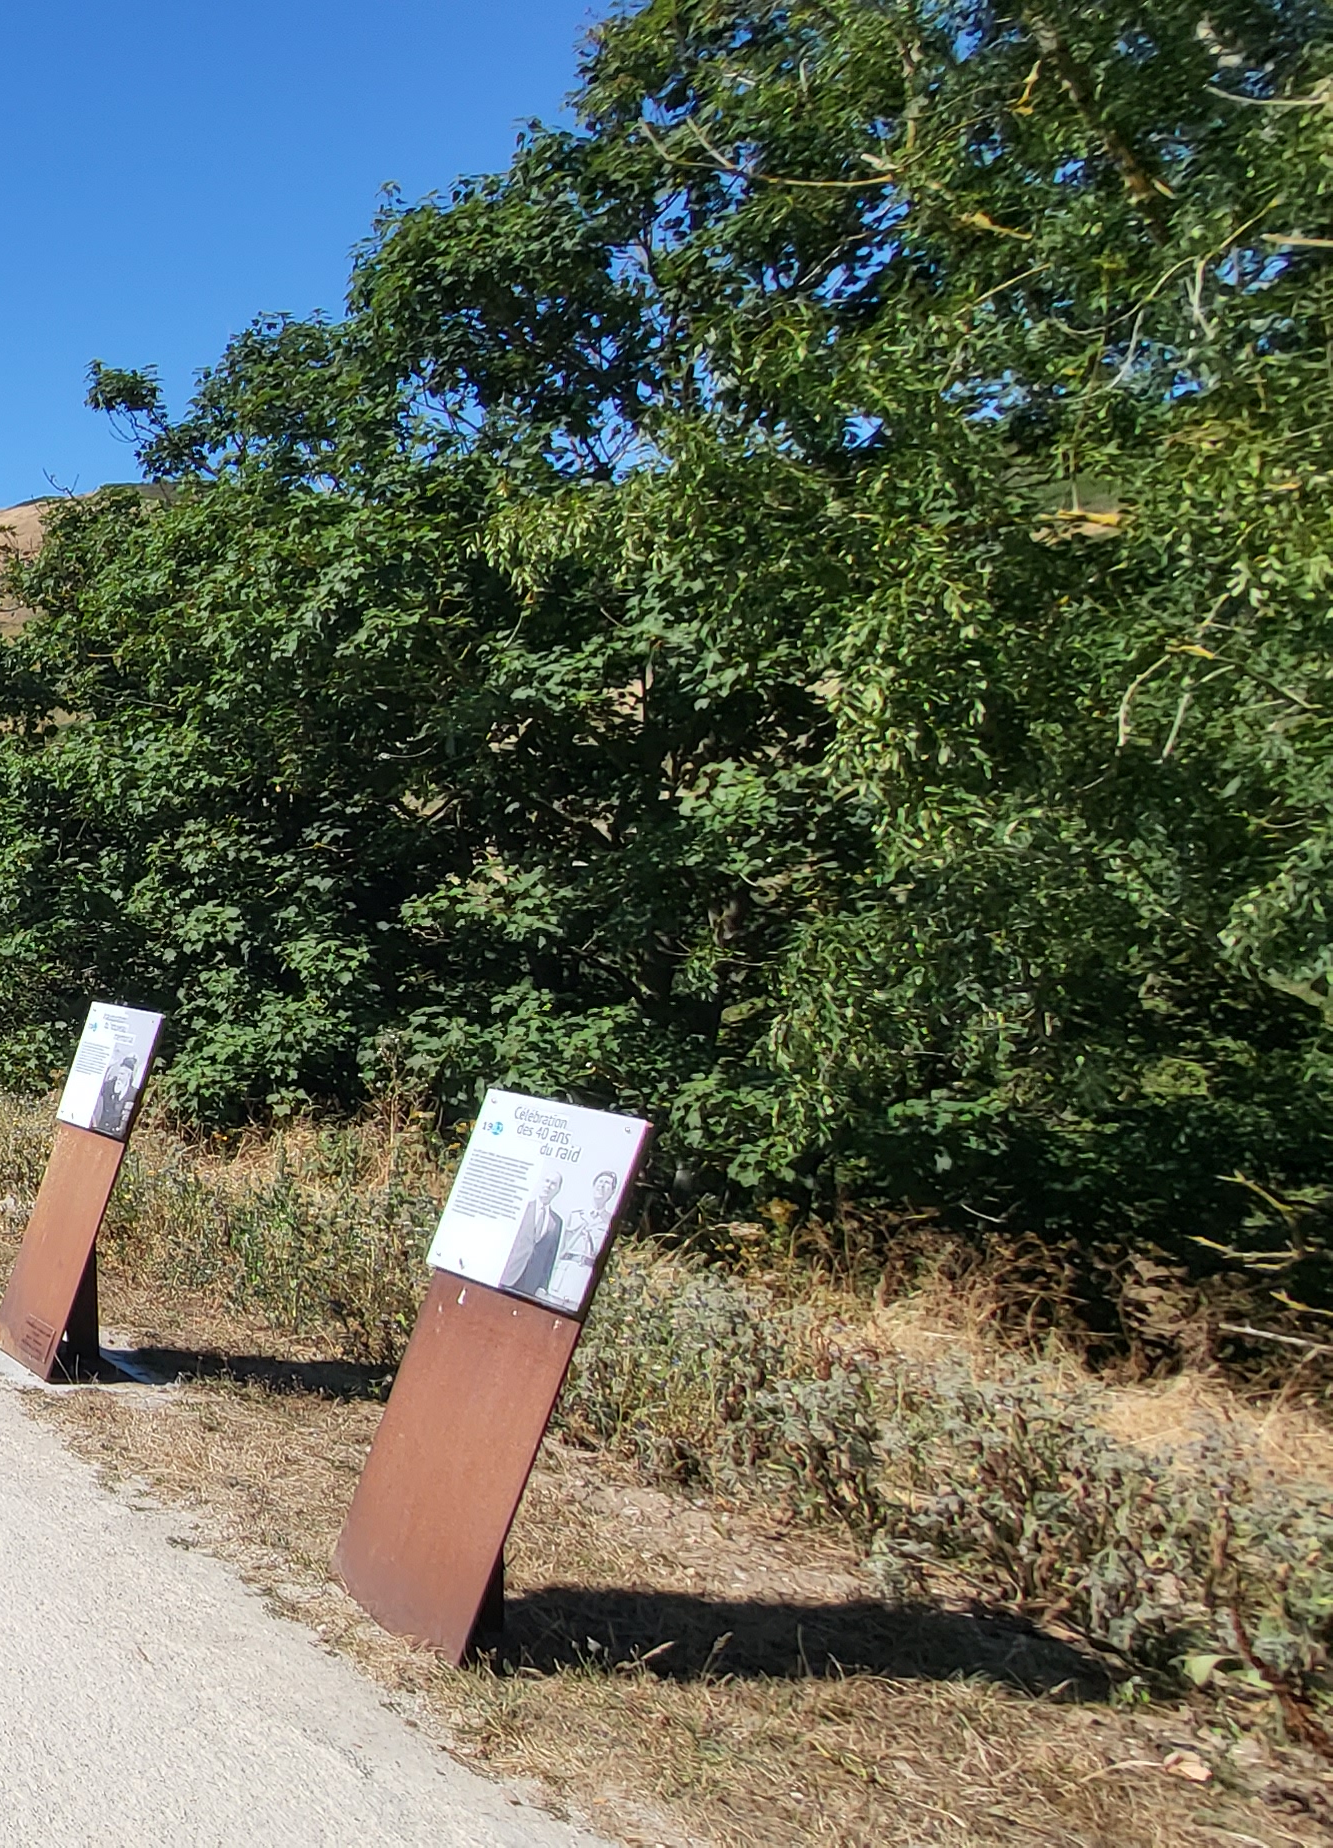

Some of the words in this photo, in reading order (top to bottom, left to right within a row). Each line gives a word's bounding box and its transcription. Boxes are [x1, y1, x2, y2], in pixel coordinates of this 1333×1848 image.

[514, 1107, 568, 1129] Célébration
[517, 1123, 534, 1136] des
[535, 1127, 549, 1140] 40
[550, 1131, 571, 1145] ans
[540, 1143, 553, 1156] du
[555, 1145, 582, 1163] raid
